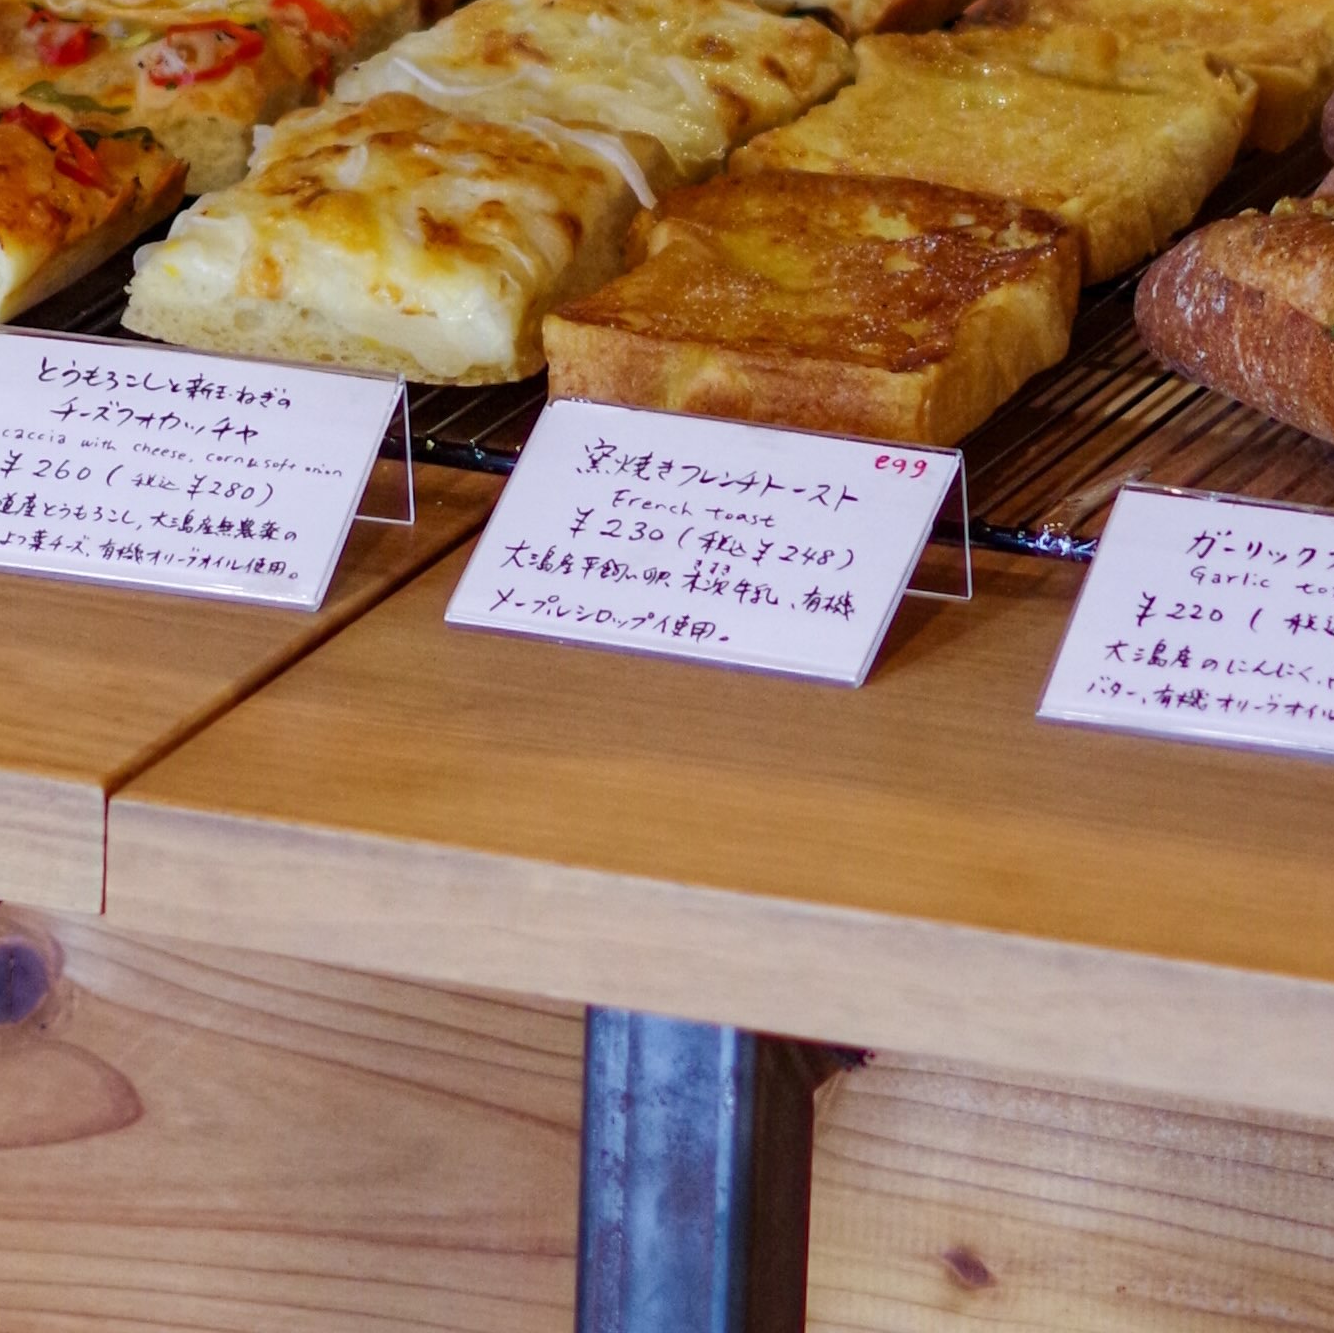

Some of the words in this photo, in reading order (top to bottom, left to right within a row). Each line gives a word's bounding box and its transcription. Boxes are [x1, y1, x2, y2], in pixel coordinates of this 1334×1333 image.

[49, 397, 260, 442] チーズフォカッチャ
[80, 436, 117, 451] with
[575, 437, 859, 512] 窯焼きフレンチトースト
[872, 454, 929, 478] egg
[611, 488, 694, 517] French
[705, 504, 777, 530] toast
[1189, 565, 1271, 589] Garlic
[489, 588, 730, 644] メープルシロップ使用。
